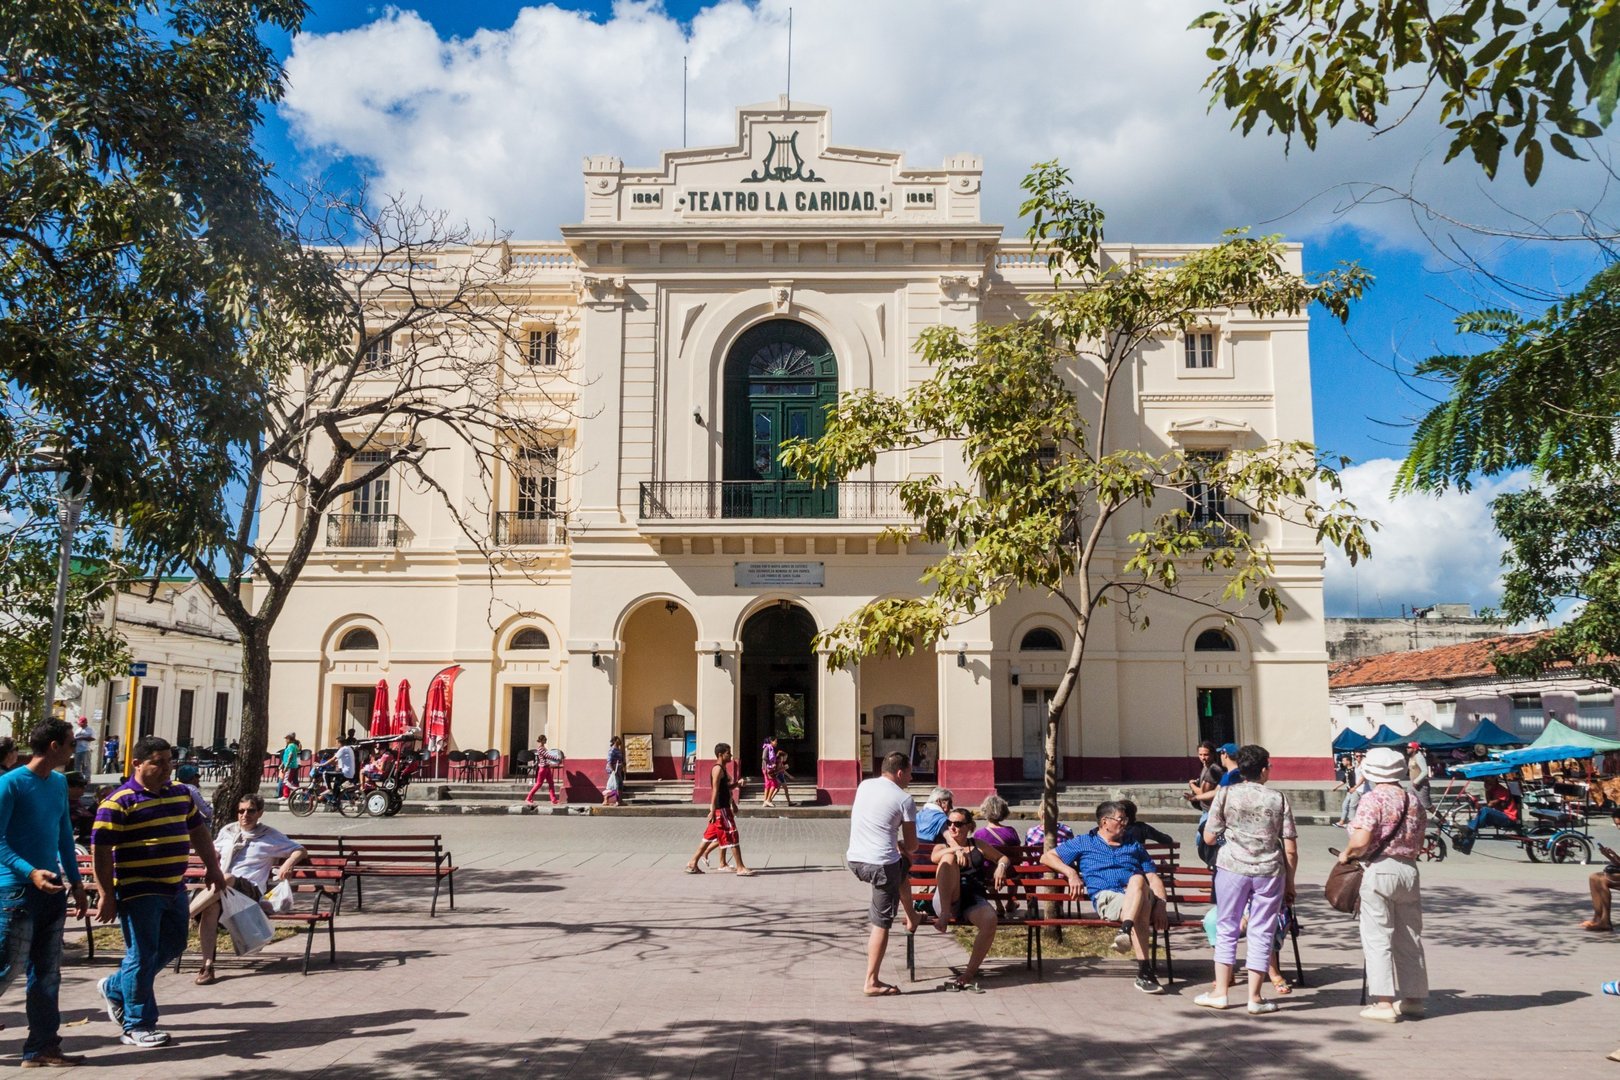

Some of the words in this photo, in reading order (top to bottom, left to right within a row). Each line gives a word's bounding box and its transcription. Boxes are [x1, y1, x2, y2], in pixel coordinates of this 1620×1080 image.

[632, 192, 660, 204] 1884
[687, 191, 759, 212] TEATRO
[765, 191, 788, 212] LA
[795, 191, 877, 212] CARIDAD.
[906, 192, 934, 204] 1885
